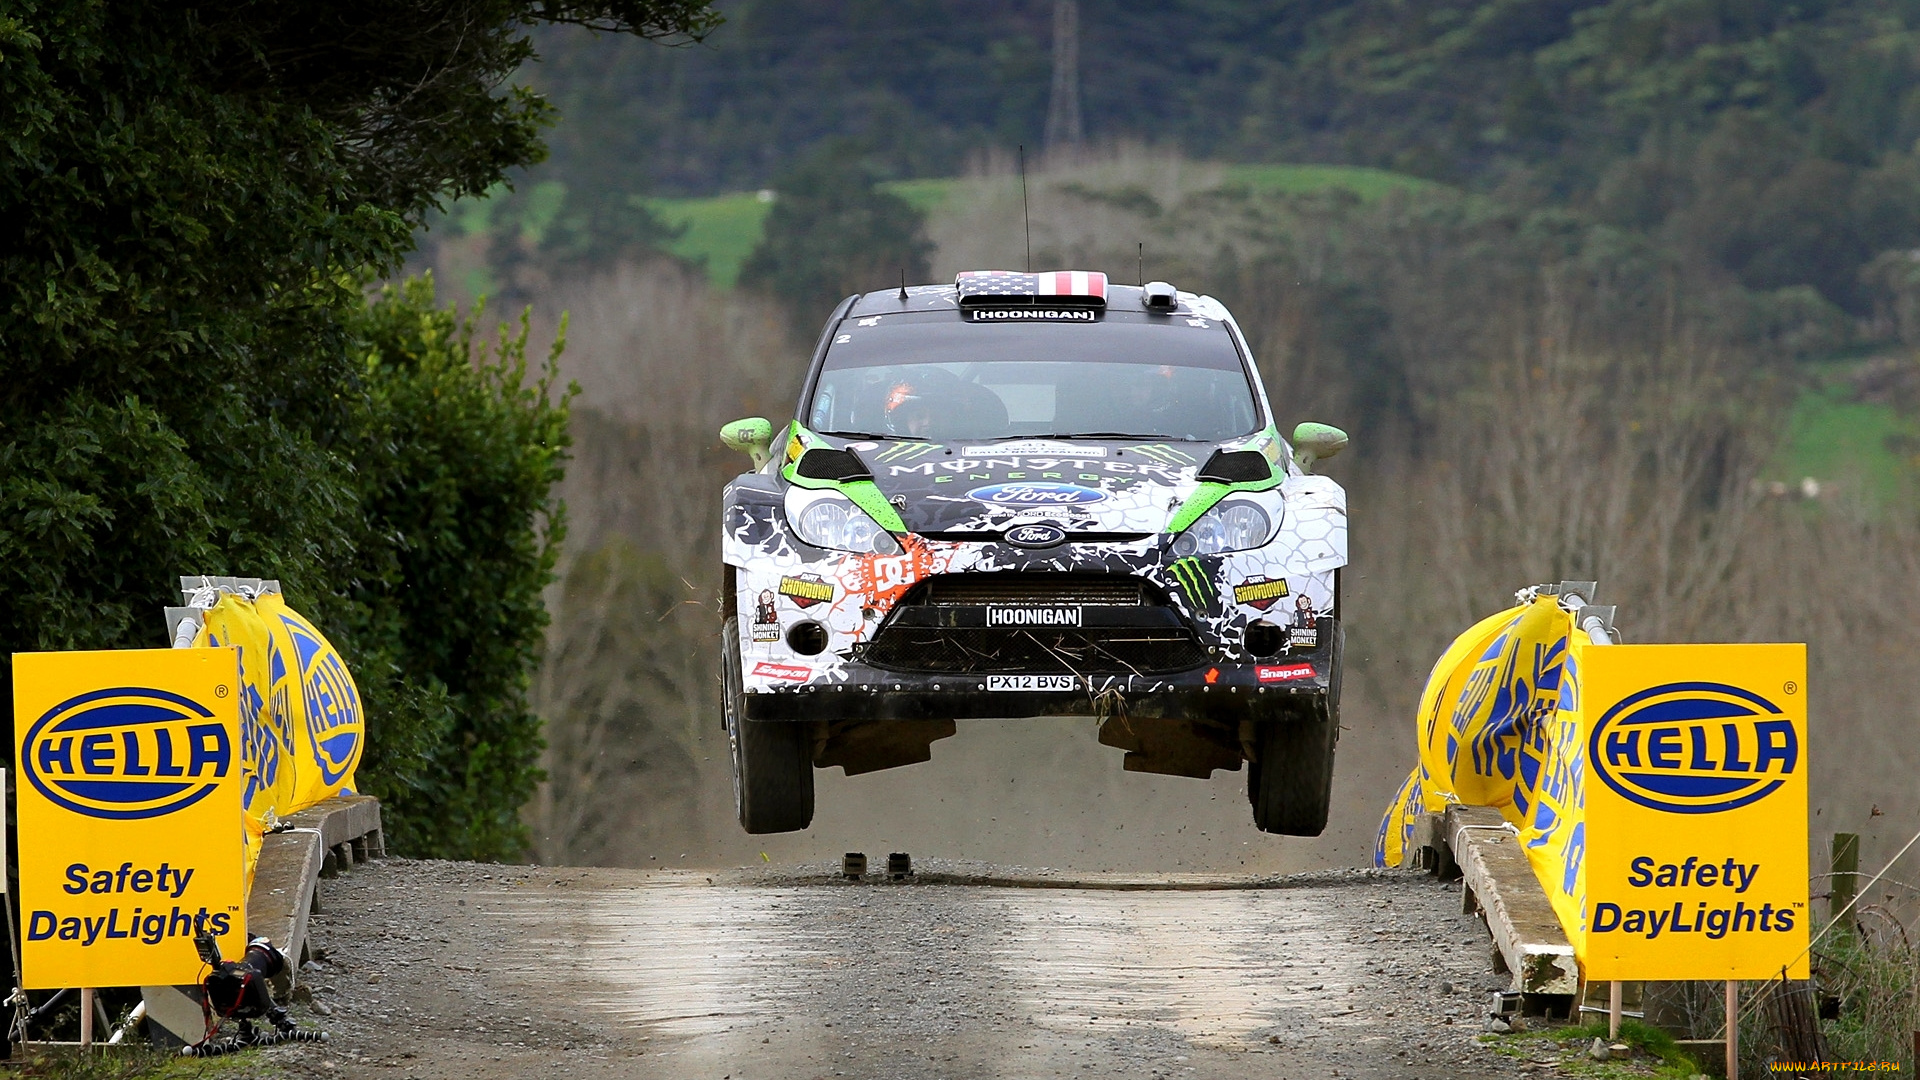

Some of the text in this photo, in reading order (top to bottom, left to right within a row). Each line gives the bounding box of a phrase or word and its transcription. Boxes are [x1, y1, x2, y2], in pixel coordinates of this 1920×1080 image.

[934, 472, 1133, 484] ENERGY
[992, 485, 1080, 502] Ford
[1017, 526, 1051, 541] Ford
[780, 577, 834, 601] SHOWDOWN
[1234, 580, 1288, 603] SHOWDOWN
[753, 623, 779, 631] SHINING
[1290, 628, 1317, 637] SHINING
[753, 631, 779, 640] MONKEY
[1290, 636, 1317, 645] MONKEY
[755, 665, 810, 677] Snap-on
[990, 677, 1070, 688] PX12 BVS
[38, 723, 231, 777] HELLA
[1606, 720, 1798, 774] HELLA
[63, 862, 194, 898] Safety
[1628, 856, 1759, 893] Safety
